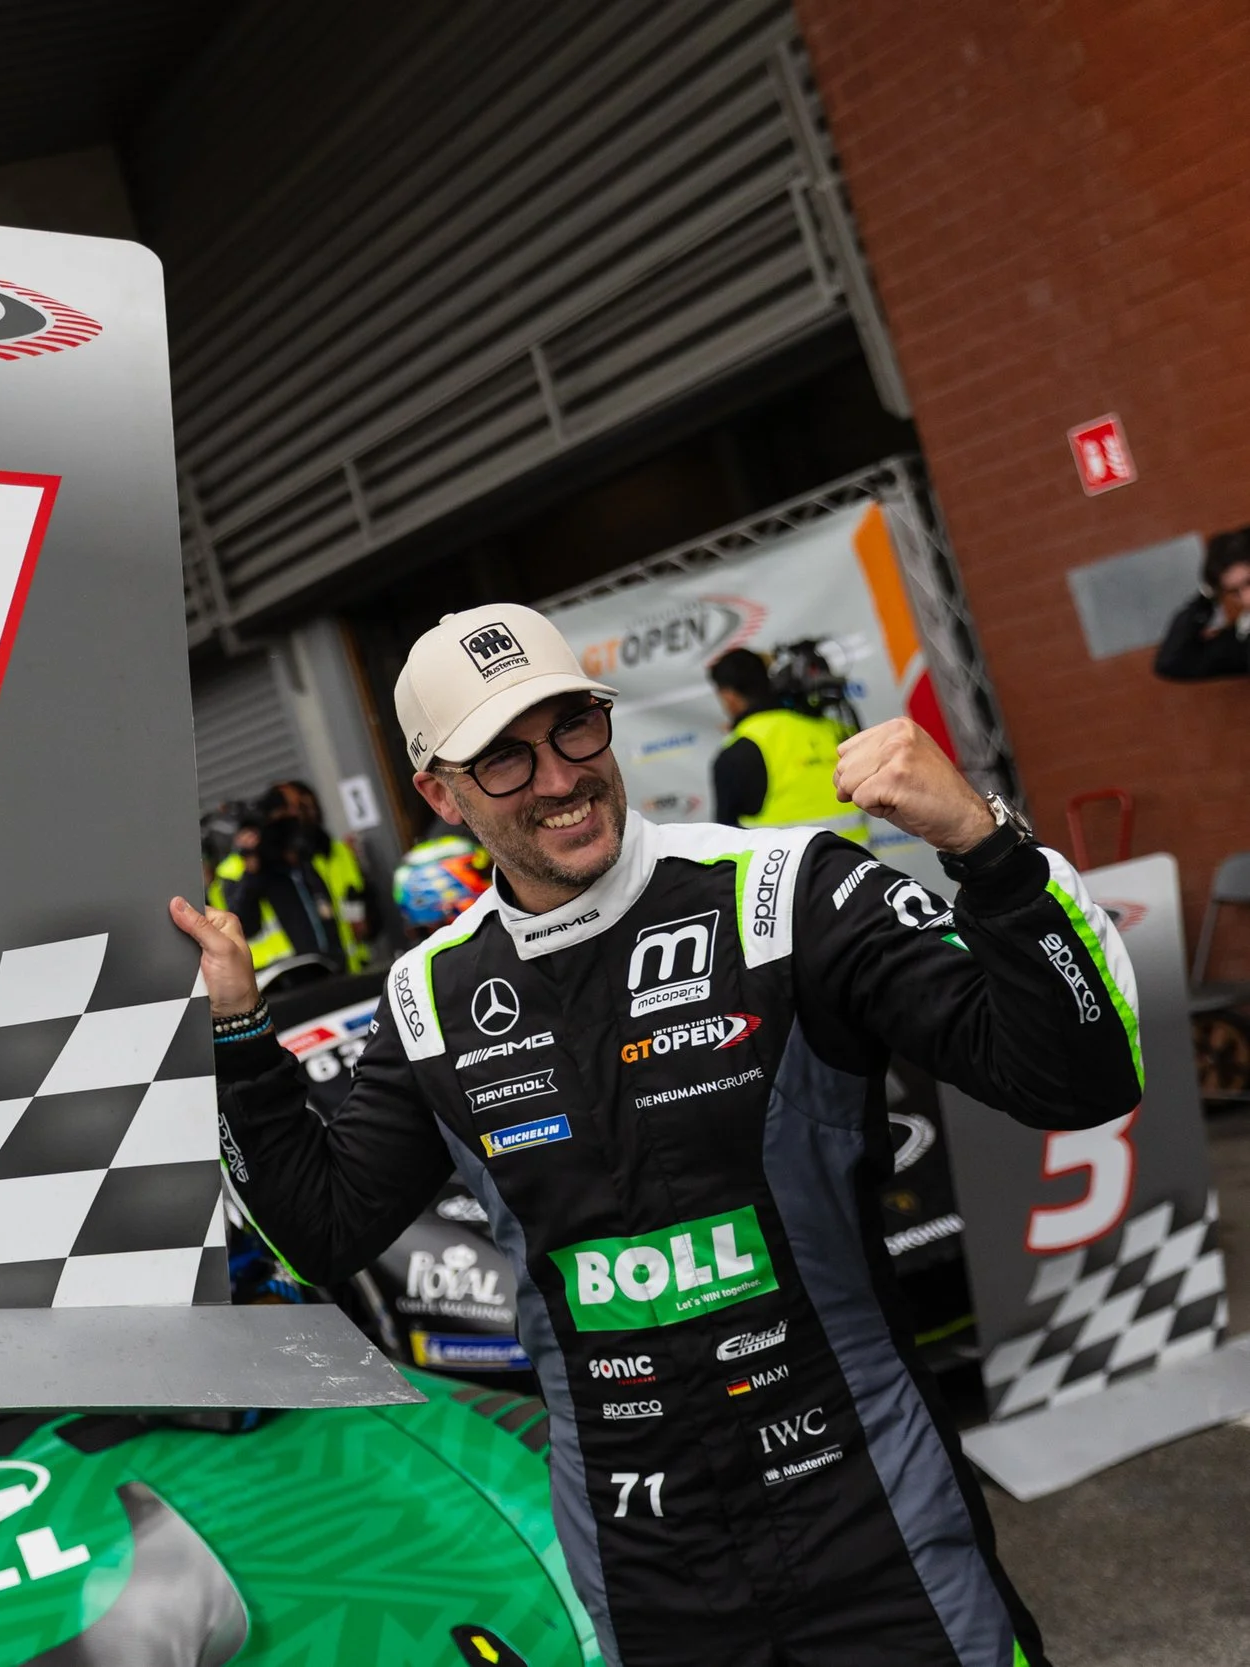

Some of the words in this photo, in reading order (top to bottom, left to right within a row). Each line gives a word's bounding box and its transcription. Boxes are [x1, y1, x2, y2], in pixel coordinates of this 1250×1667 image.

[482, 656, 529, 680] Musterring
[410, 732, 428, 765] IWC
[753, 848, 790, 939] sparco
[547, 909, 600, 937] AMG
[1038, 933, 1101, 1024] sparco
[394, 967, 425, 1042] sparco
[638, 984, 705, 1010] motopark
[653, 1014, 723, 1036] INTERNATIONAL
[484, 1031, 555, 1060] AMG
[476, 1078, 545, 1105] RAVENOL
[502, 1123, 561, 1147] MICHELIN
[575, 1222, 754, 1306] BOLL
[752, 1364, 789, 1389] MAXI
[603, 1400, 663, 1420] sparco
[758, 1407, 827, 1454] IWC
[611, 1472, 665, 1518] 71
